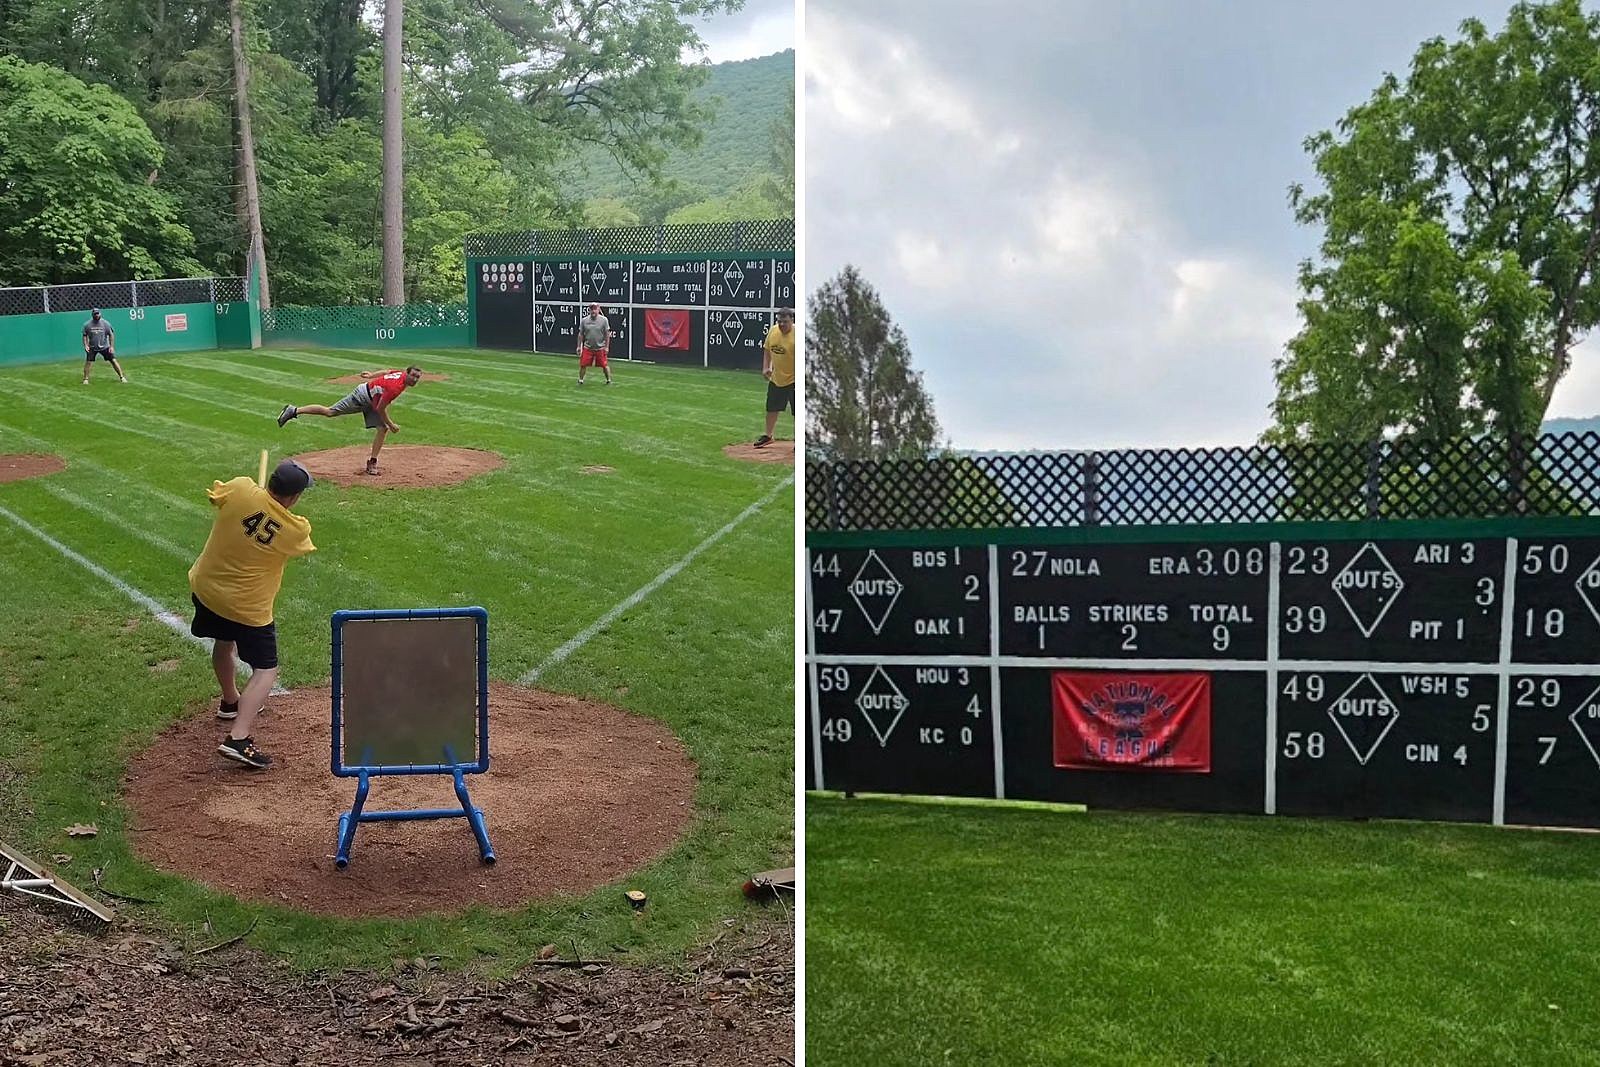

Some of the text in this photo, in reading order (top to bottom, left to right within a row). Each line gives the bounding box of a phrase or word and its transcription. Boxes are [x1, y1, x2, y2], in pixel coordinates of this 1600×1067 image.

[582, 264, 589, 273] 44
[636, 262, 647, 273] 27
[686, 263, 706, 273] 3.08
[711, 262, 724, 273] 23
[746, 261, 763, 269] ARI 3
[777, 262, 790, 273] 50
[572, 273, 577, 283] 3
[623, 272, 628, 282] 2
[764, 274, 770, 286] 3
[665, 292, 670, 302] 2
[690, 292, 696, 302] 9
[711, 285, 722, 296] 39
[778, 287, 790, 298] 18
[129, 309, 145, 320] 93
[216, 304, 230, 314] 97
[709, 312, 722, 322] 49
[622, 318, 627, 328] 4
[725, 321, 741, 329] OUTS
[763, 324, 769, 335] 5
[376, 328, 395, 340] 100
[710, 334, 722, 345] 58
[744, 339, 763, 348] CIN 4
[241, 510, 282, 545] 45
[913, 547, 961, 567] BOS 1
[1287, 548, 1329, 575] 23
[1414, 543, 1474, 564] ARI 3
[1523, 545, 1568, 574] 50
[813, 554, 842, 578] 44
[1012, 549, 1264, 577] 27 NOLA ERA 3.08
[855, 580, 896, 597] OUTS
[964, 575, 980, 601] 2
[1342, 571, 1394, 588] OUTS
[1475, 578, 1495, 606] 3
[815, 609, 843, 633] 47
[1014, 605, 1253, 624] BALLS STRIKES TOTAL
[1286, 606, 1327, 633] 39
[1525, 609, 1564, 637] 18
[914, 617, 964, 635] OAK 1
[1410, 619, 1464, 639] PIT 1
[1038, 625, 1230, 651] 1 2 9
[820, 668, 850, 691] 59
[916, 668, 969, 686] HOU 3
[1282, 676, 1325, 702] 49
[1401, 677, 1469, 698] WSH 5
[1516, 679, 1561, 707] 29
[863, 694, 902, 710] OUTS
[967, 694, 982, 718] 4
[1081, 681, 1178, 717] NATIONAL
[1339, 699, 1390, 716] OUTS
[1472, 705, 1491, 732] 5
[822, 719, 852, 742] 49
[920, 727, 973, 745] KC 0
[1083, 737, 1174, 757] LEAGUE
[1283, 733, 1325, 758] 58
[1538, 737, 1557, 765] 7
[1406, 745, 1467, 766] CIN 4
